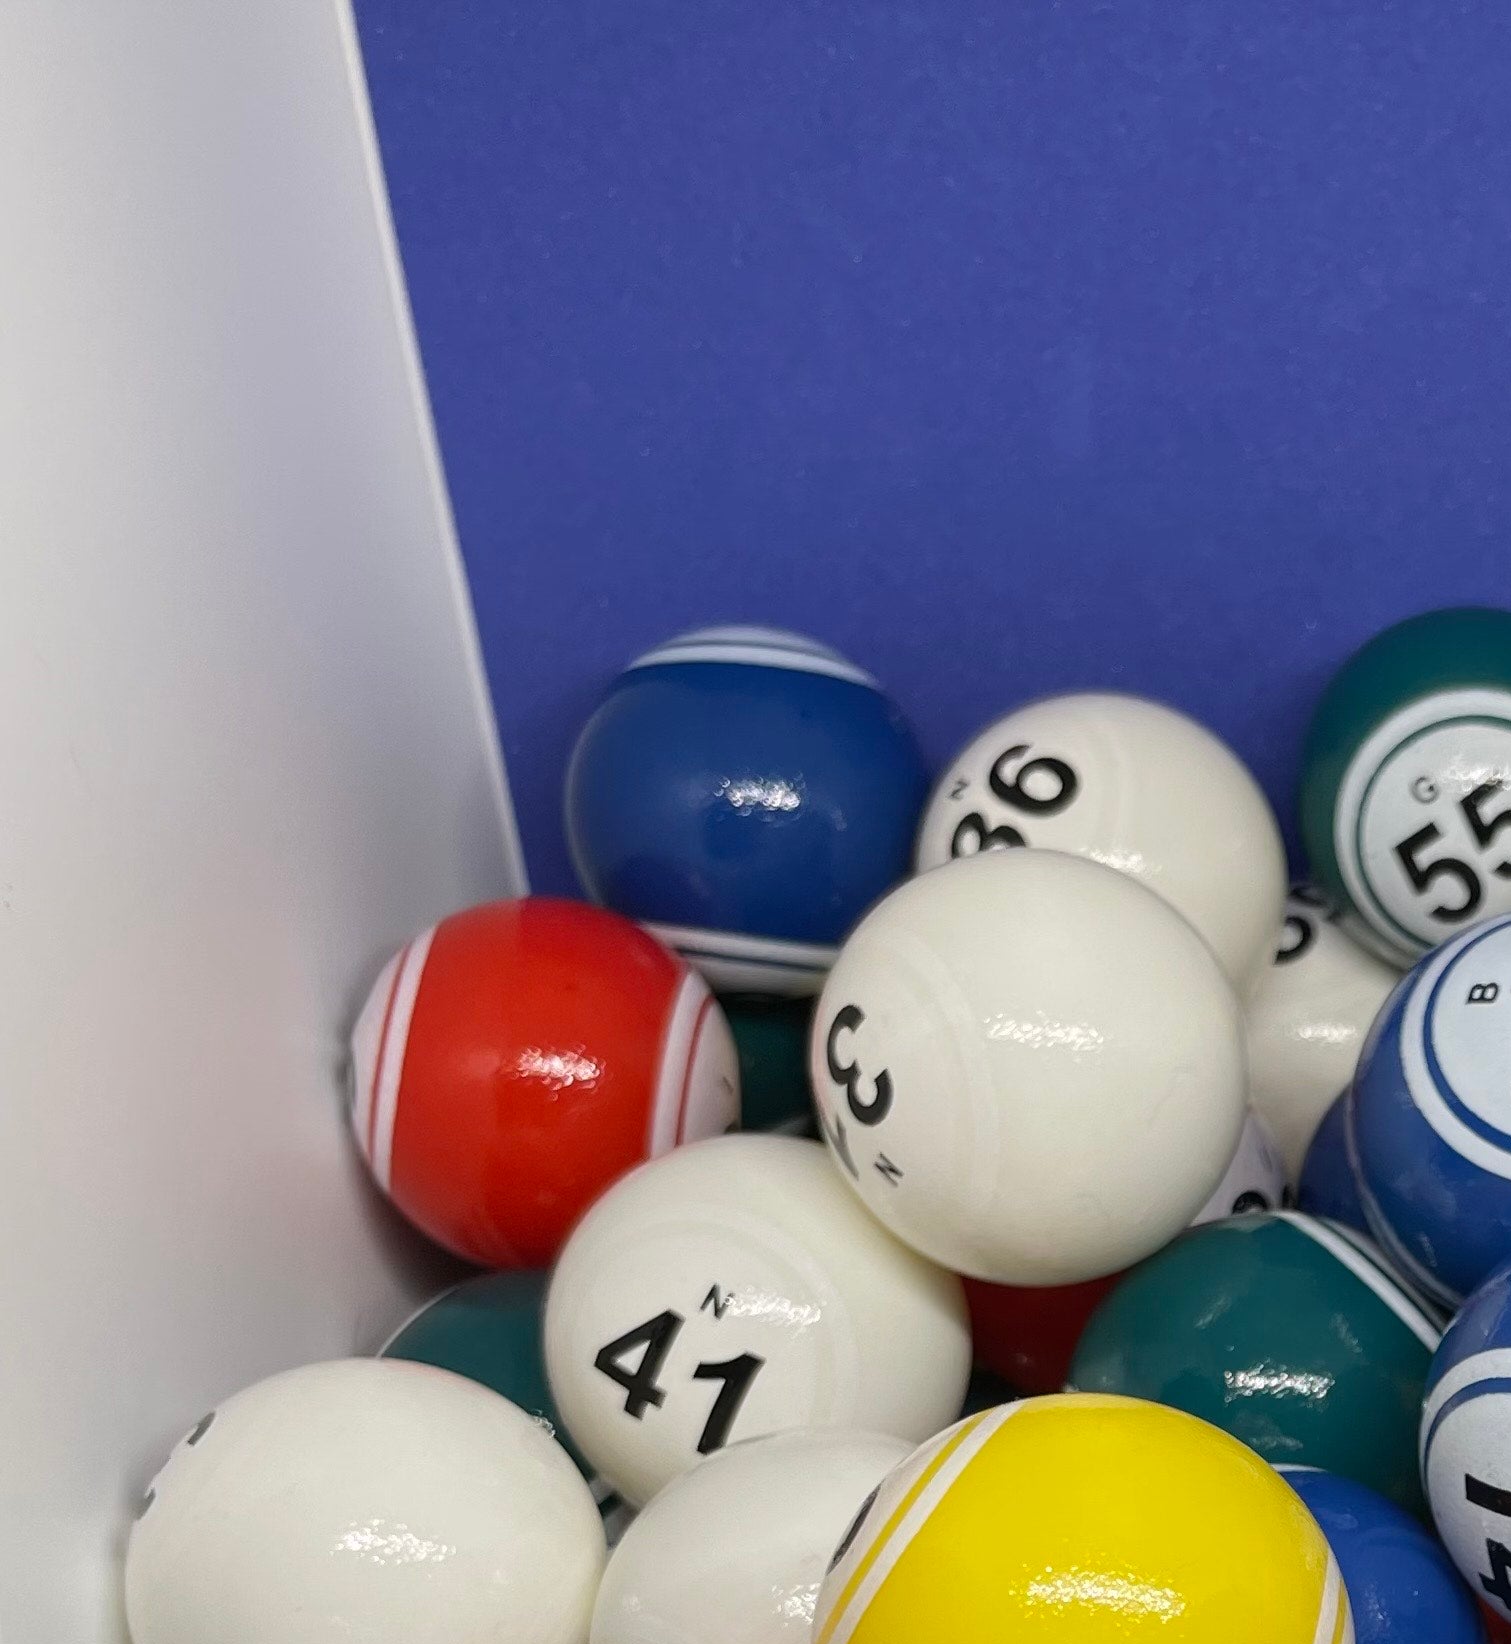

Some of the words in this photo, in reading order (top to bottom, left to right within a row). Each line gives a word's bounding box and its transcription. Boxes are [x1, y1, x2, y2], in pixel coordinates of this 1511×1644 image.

[1411, 775, 1439, 803] G
[1466, 982, 1499, 1004] B
[875, 1153, 903, 1186] N
[700, 1284, 735, 1319] N
[594, 1310, 766, 1455] 41
